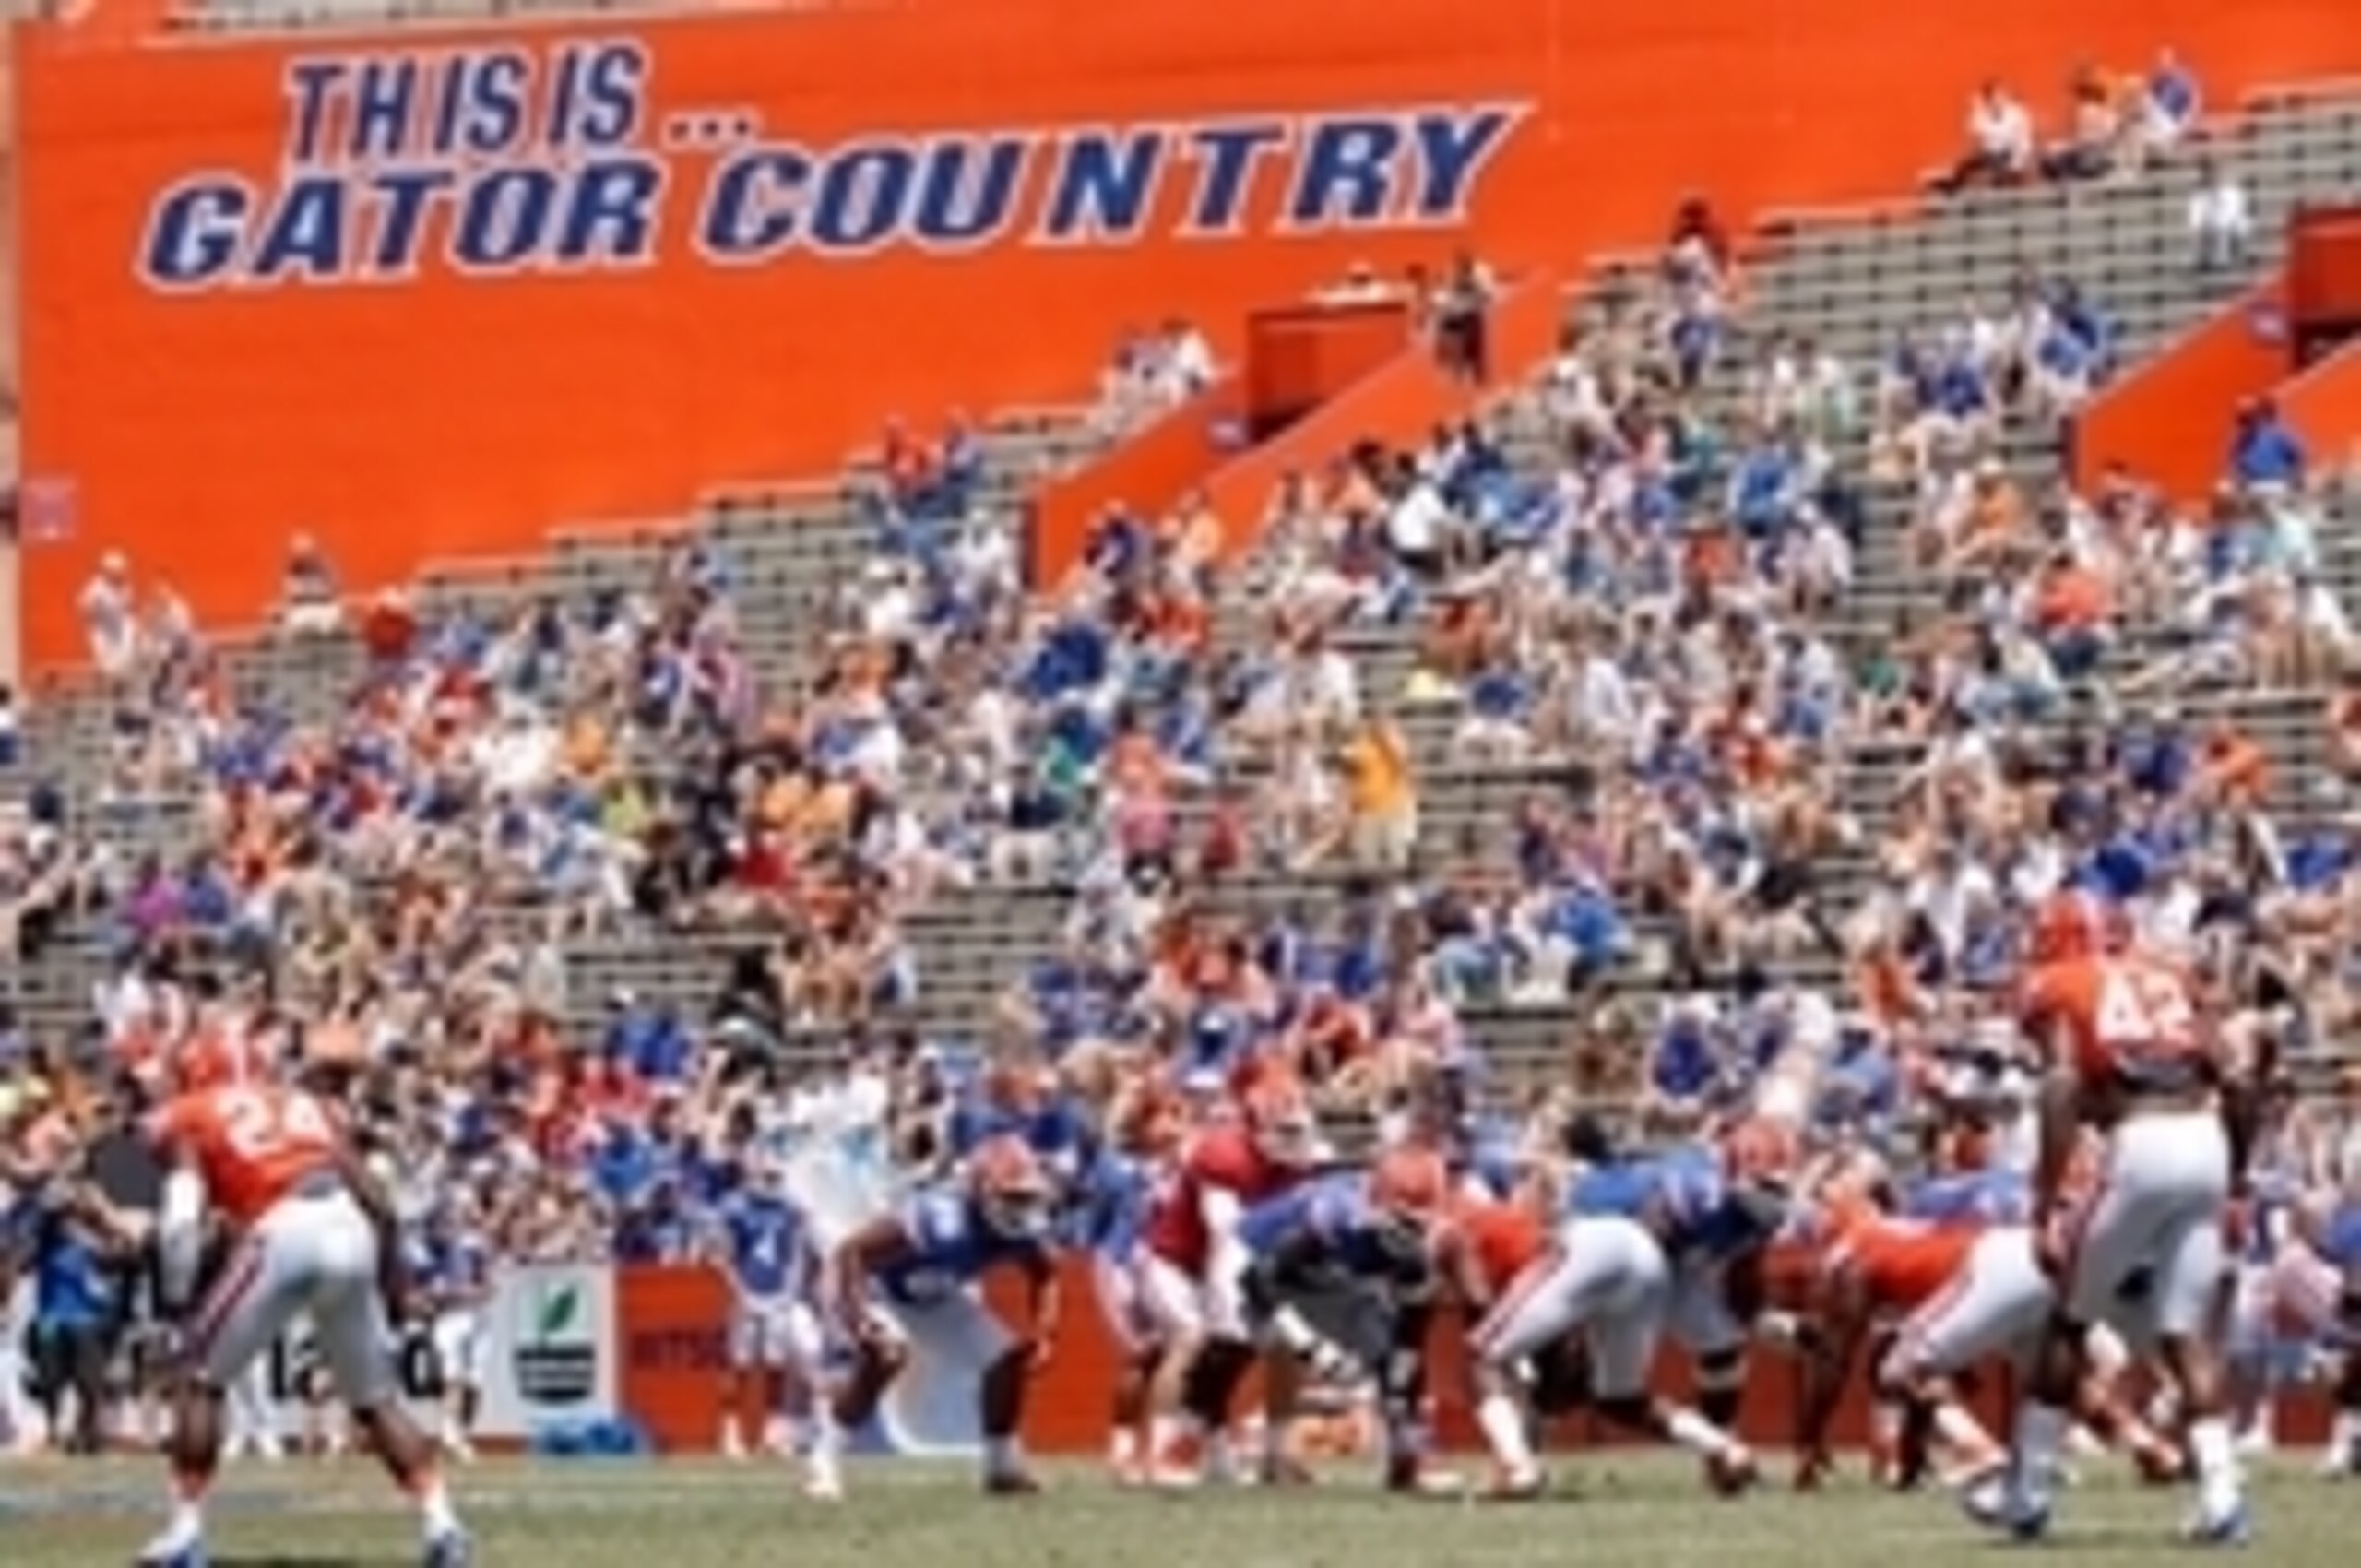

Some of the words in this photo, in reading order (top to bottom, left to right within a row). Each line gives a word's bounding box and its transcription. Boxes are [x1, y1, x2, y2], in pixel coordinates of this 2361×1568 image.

[288, 50, 535, 164] THIS
[138, 153, 666, 290] GATOR
[694, 101, 1526, 262] COUNTRY
[2095, 968, 2195, 1044] 42
[214, 1086, 332, 1158] 24
